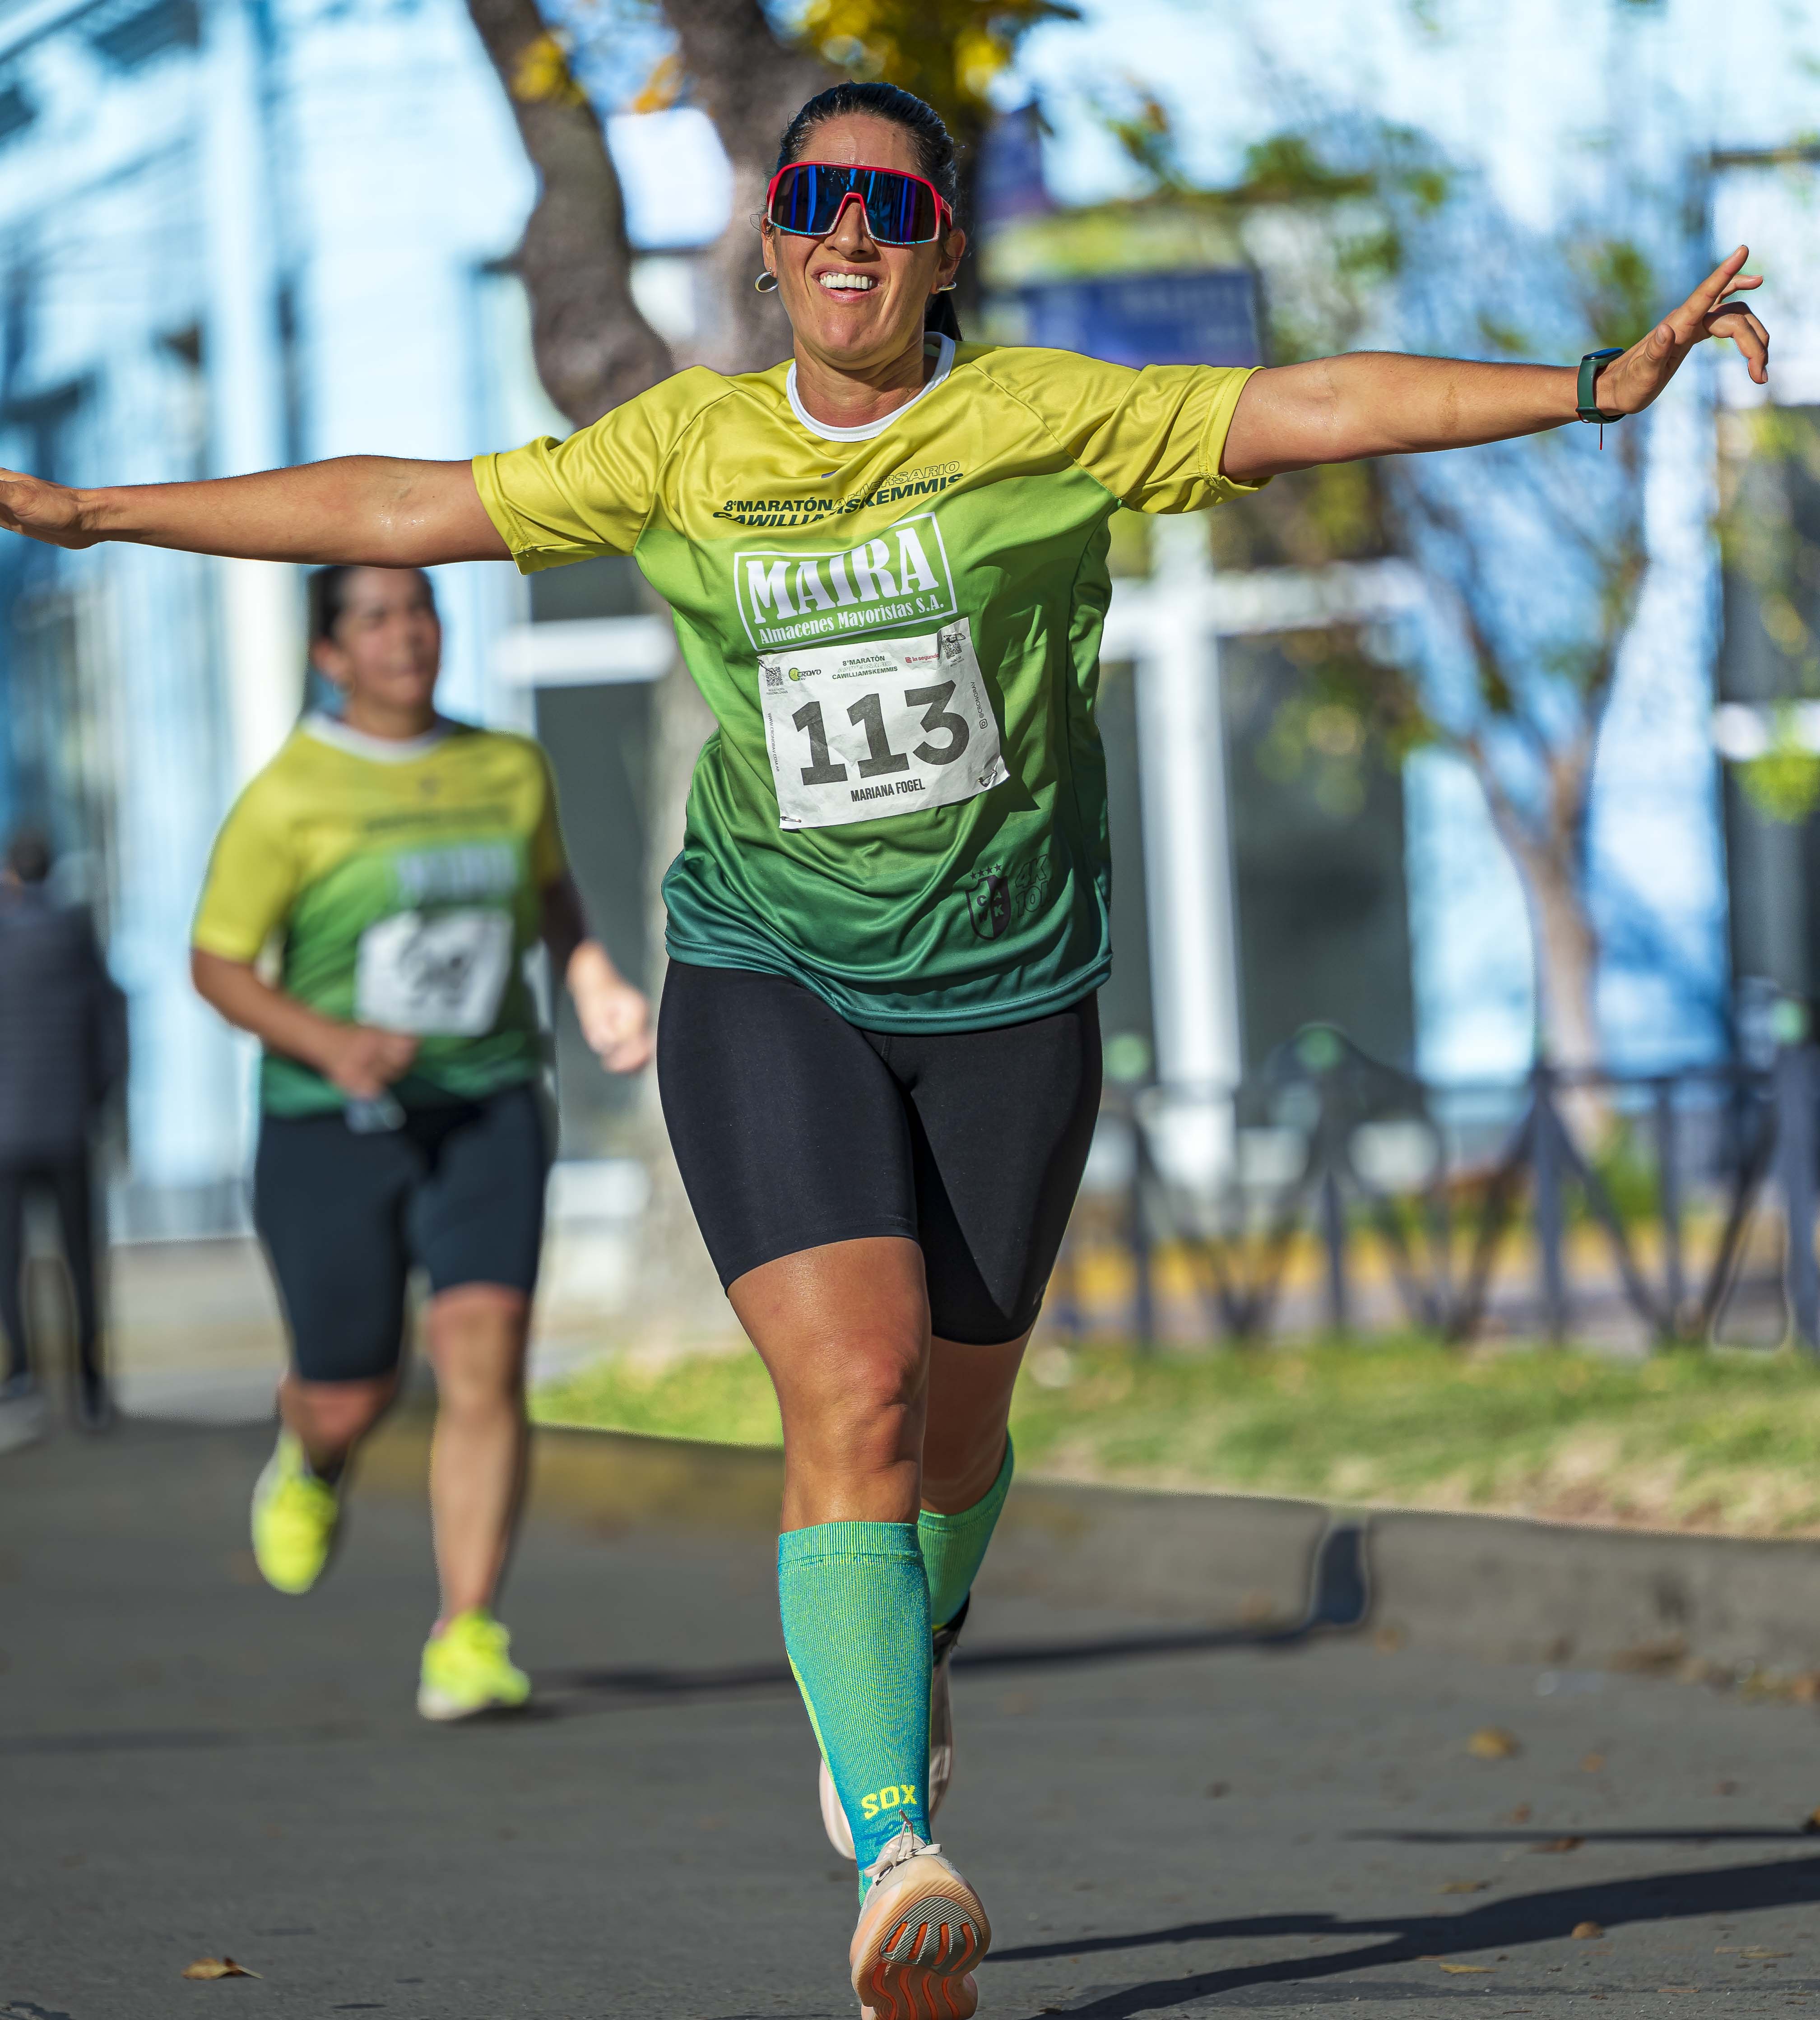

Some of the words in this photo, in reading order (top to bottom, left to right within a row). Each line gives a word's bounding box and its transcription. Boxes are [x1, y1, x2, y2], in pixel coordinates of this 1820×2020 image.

[746, 527, 939, 624] MAIRA
[759, 616, 835, 644] Almacenes
[838, 600, 913, 629] Mayoristas
[918, 596, 944, 613] S.A.
[832, 666, 898, 680] CAWILLIAMSKEMMIS
[970, 682, 984, 718] @CRONORAV
[792, 680, 970, 786] 113
[850, 783, 895, 802] MARIANA
[896, 778, 926, 794] FOGEL
[861, 1784, 917, 1820] SOX
